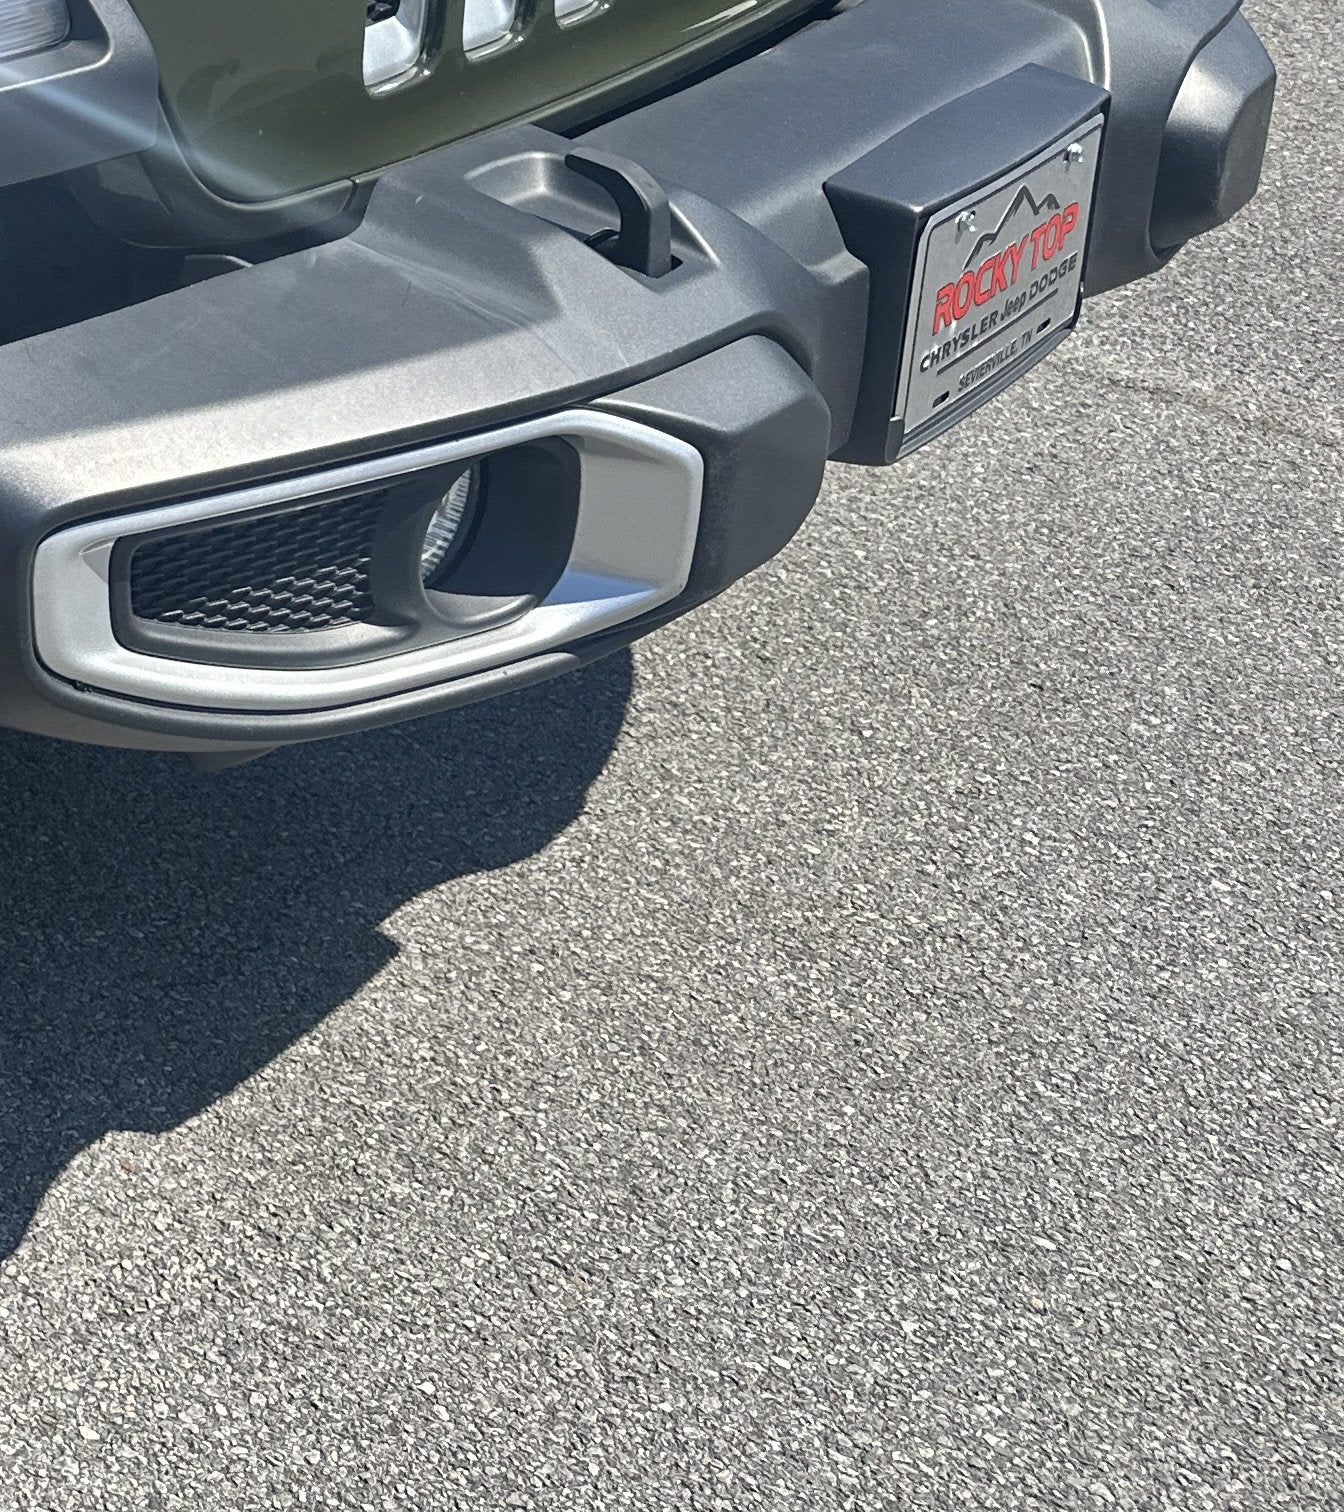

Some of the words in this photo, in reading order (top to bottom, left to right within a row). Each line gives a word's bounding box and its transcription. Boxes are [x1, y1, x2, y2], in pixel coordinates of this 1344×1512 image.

[919, 310, 999, 373] CHRYSLER
[999, 290, 1027, 321] Jeep
[1028, 251, 1078, 302] DODGE
[931, 233, 1030, 337] ROCKY
[1030, 201, 1080, 271] TOP
[957, 338, 1018, 392] SEVIERVILLE
